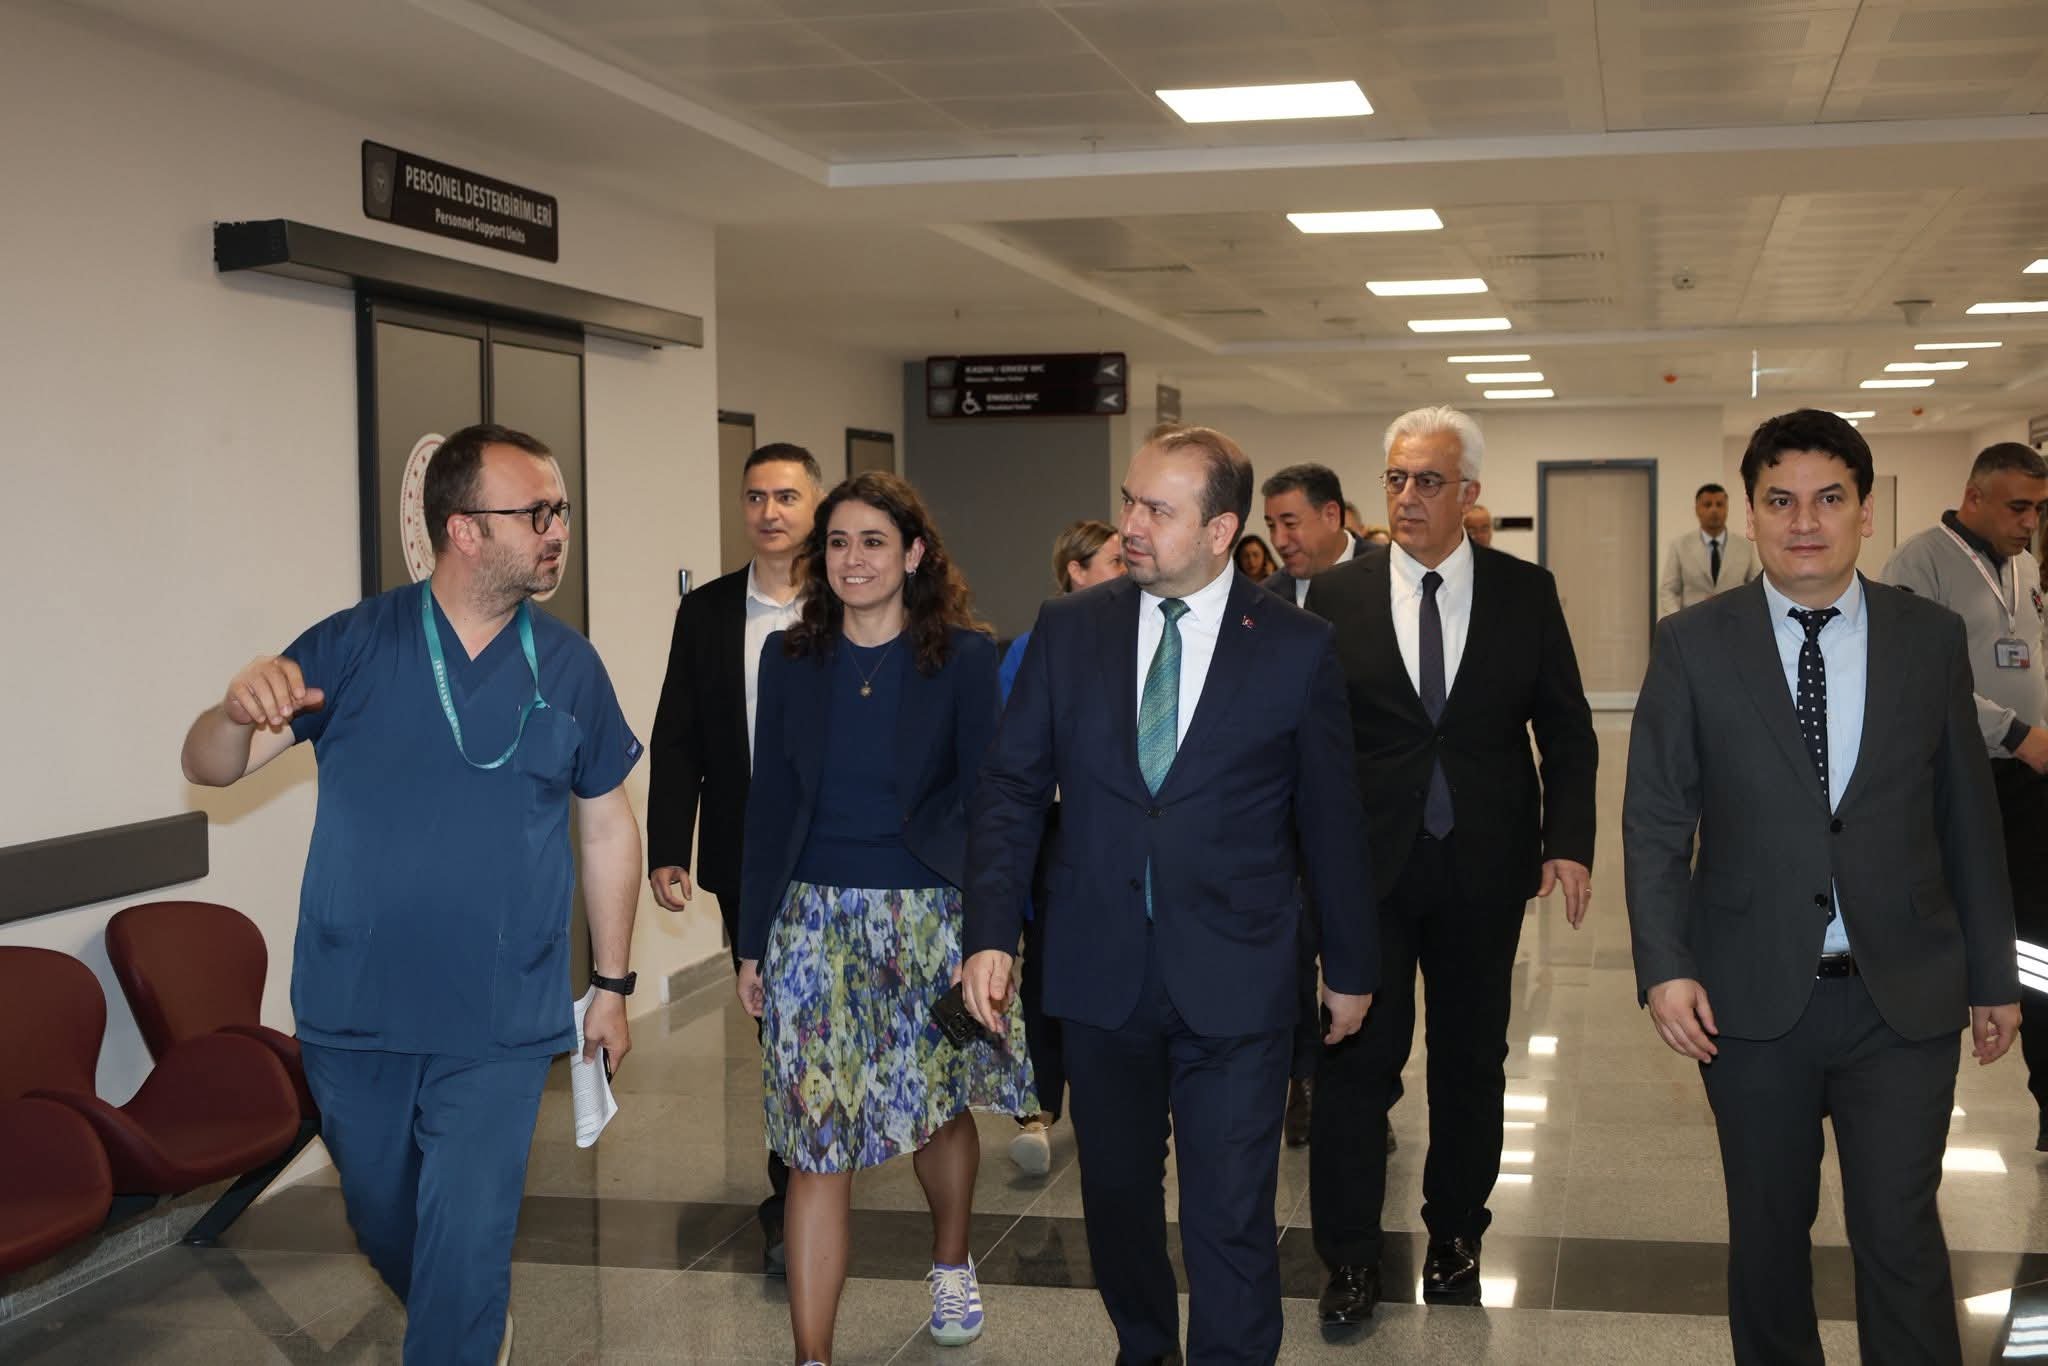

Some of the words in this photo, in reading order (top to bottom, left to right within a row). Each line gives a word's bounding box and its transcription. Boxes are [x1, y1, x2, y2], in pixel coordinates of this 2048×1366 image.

[405, 164, 464, 203] PERSONEL
[434, 207, 475, 231] Personnel
[475, 216, 507, 239] Support
[506, 226, 526, 244] Units
